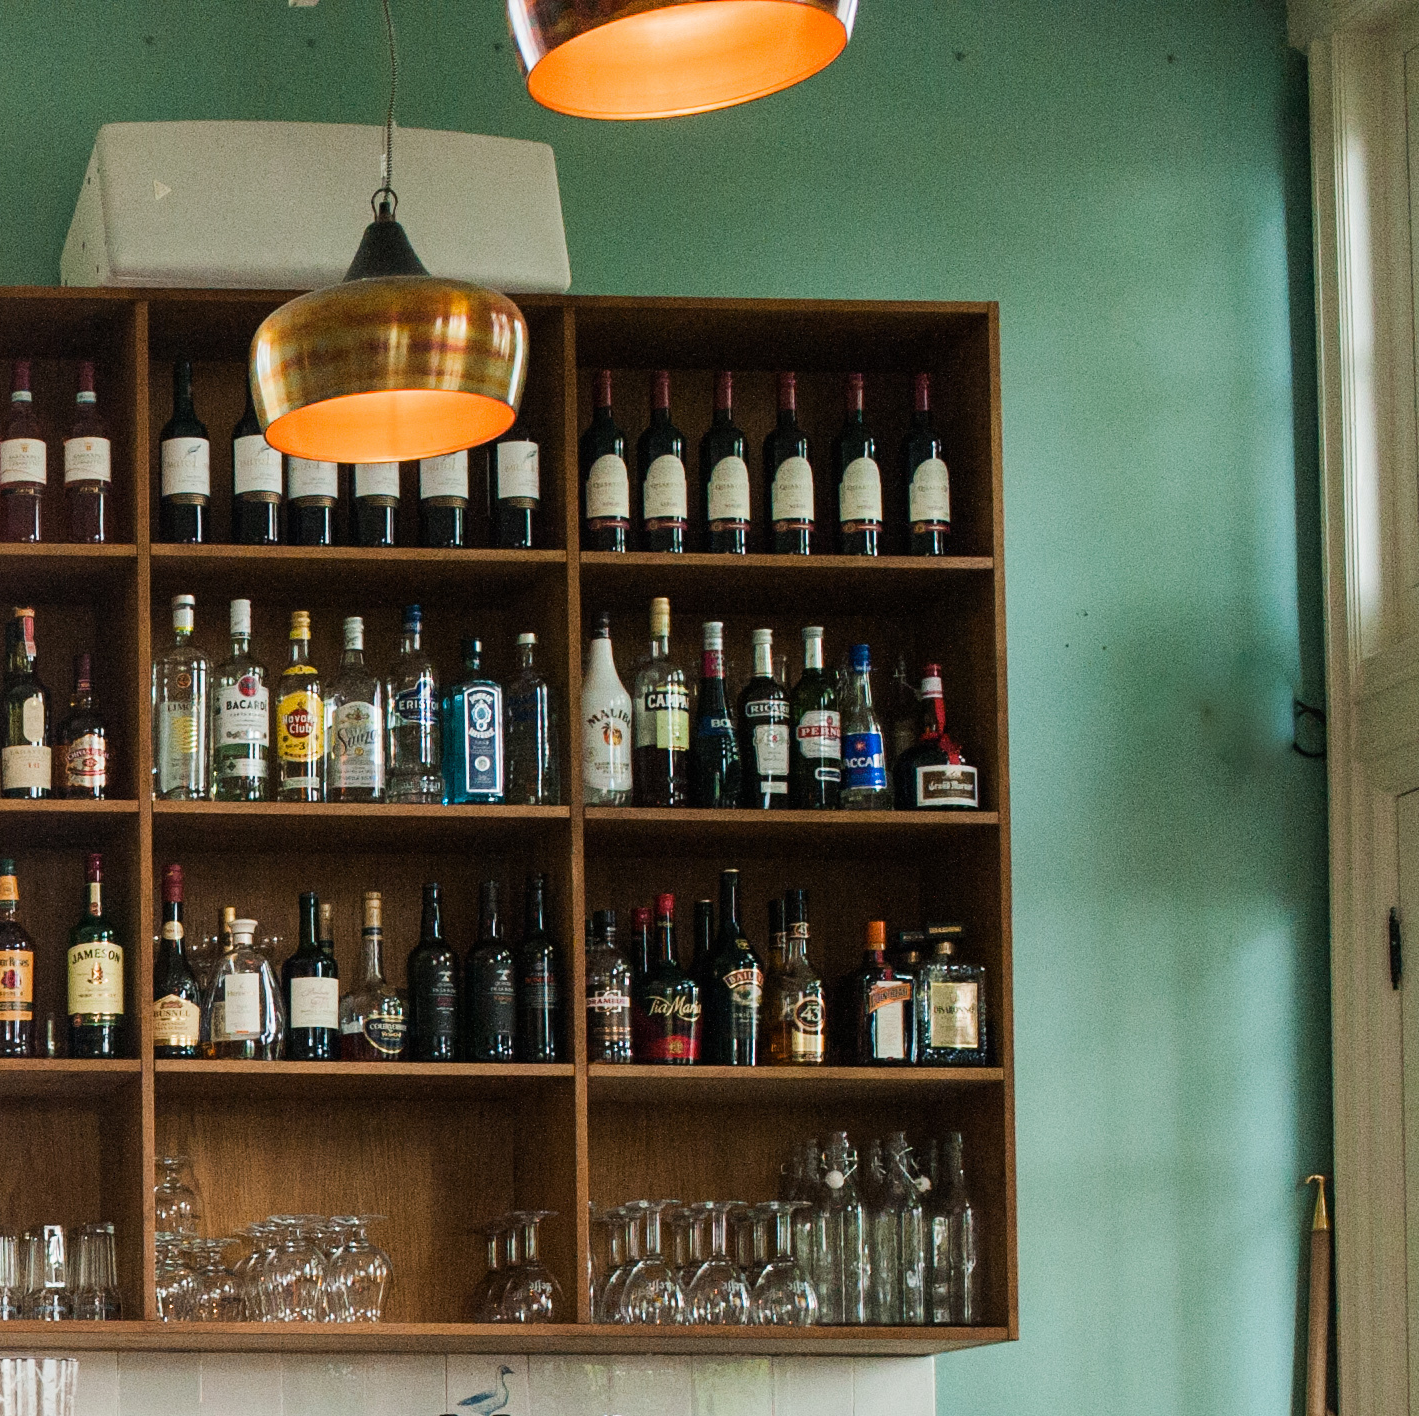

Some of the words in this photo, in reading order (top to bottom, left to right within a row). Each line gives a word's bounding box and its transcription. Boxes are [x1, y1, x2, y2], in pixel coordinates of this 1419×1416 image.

[289, 723, 312, 734] Club
[72, 949, 120, 965] JAMESON
[666, 996, 701, 1016] Maria
[800, 1005, 821, 1021] 43
